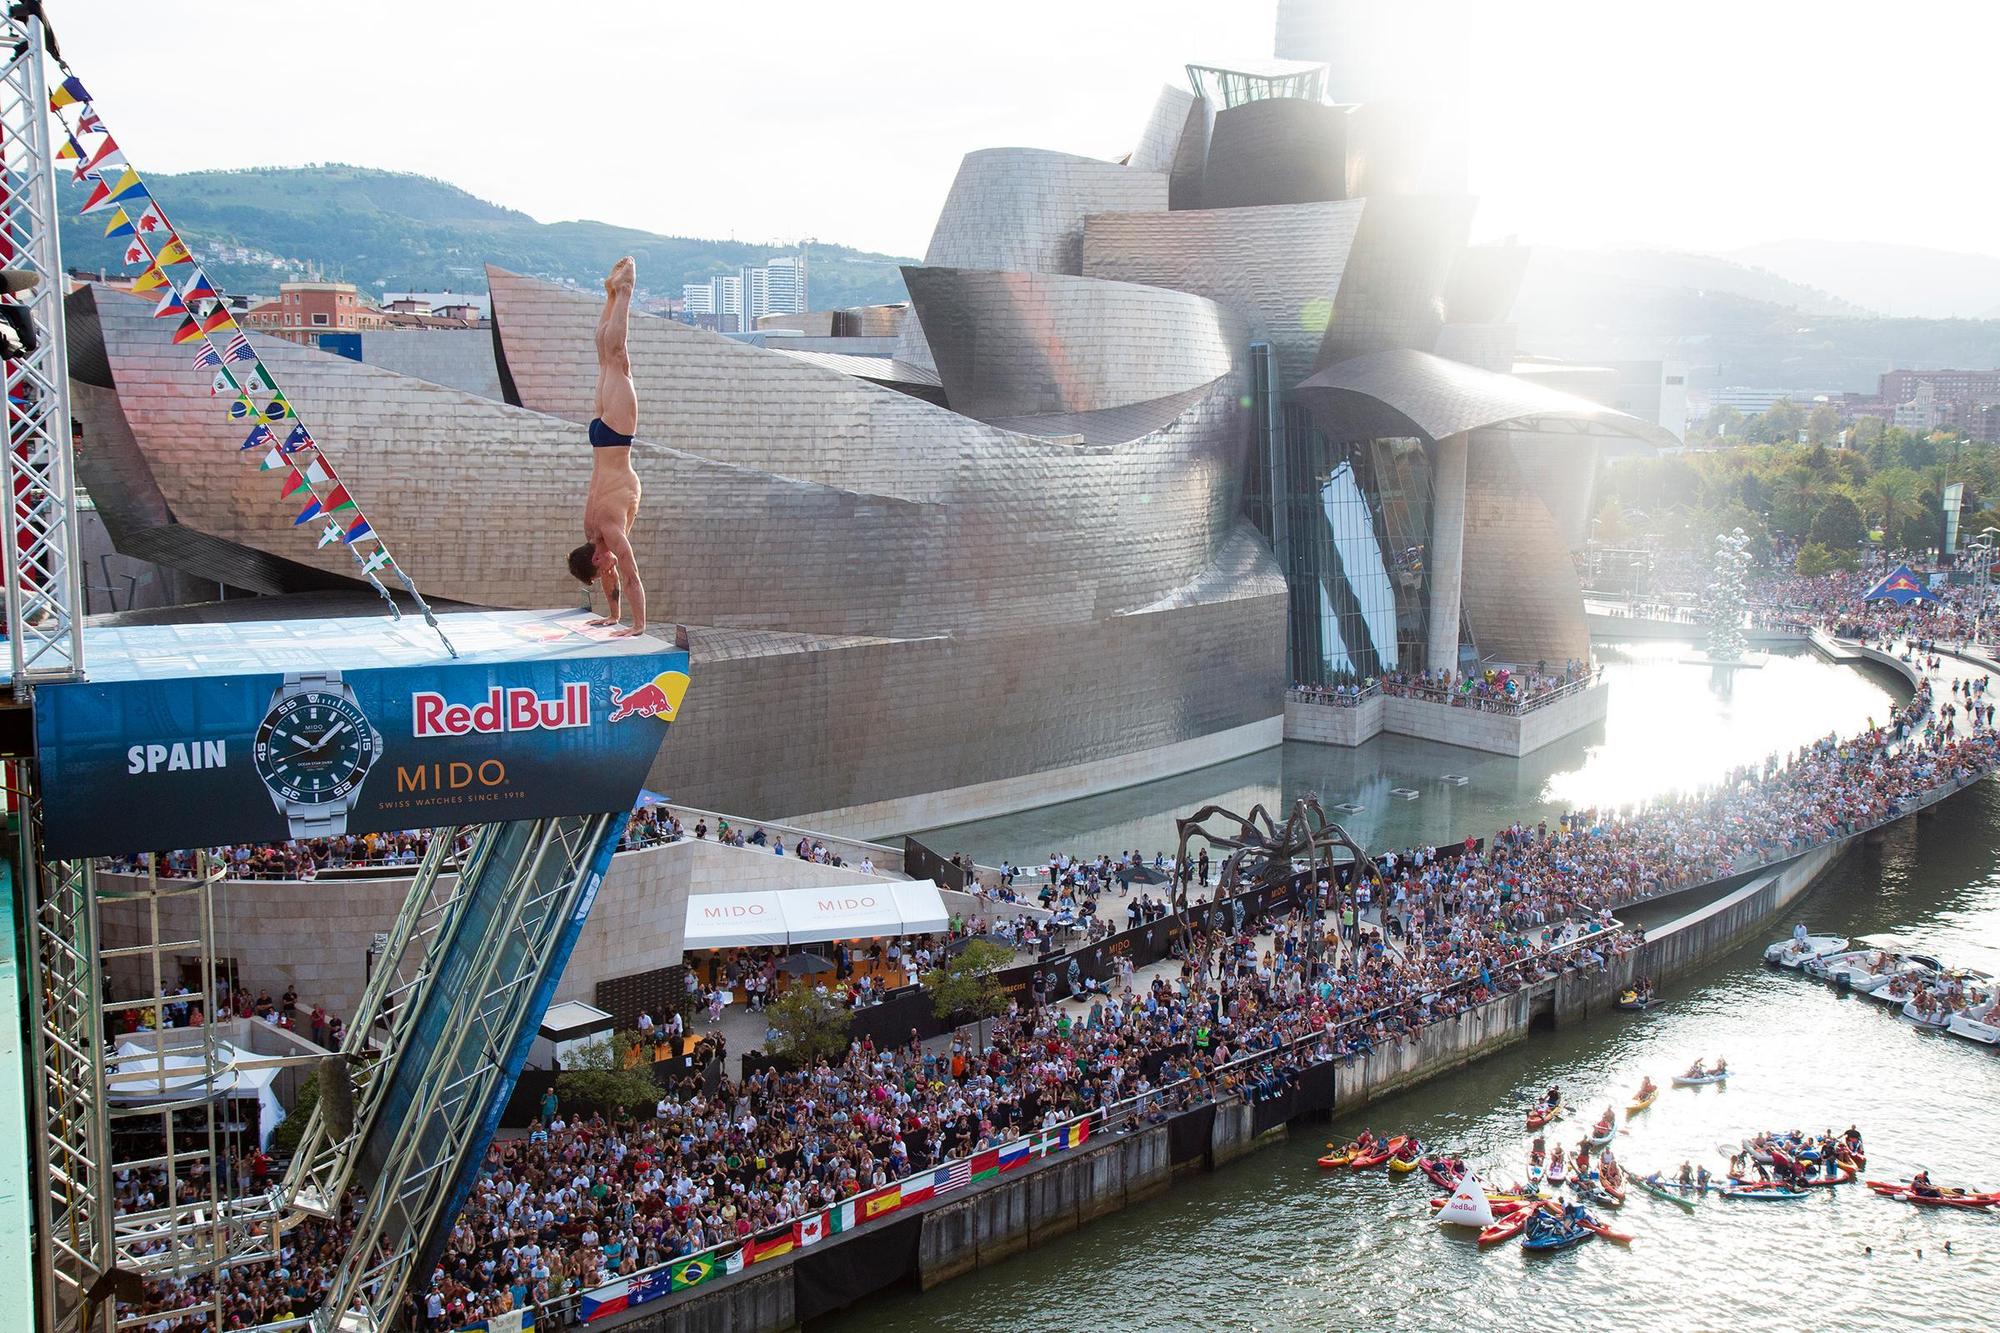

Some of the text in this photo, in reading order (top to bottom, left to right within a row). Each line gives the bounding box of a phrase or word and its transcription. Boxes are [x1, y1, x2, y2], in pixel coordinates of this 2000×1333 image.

[278, 699, 297, 715] 55
[415, 684, 590, 736] Red Bull
[257, 742, 267, 762] 45
[362, 738, 372, 751] 15
[127, 740, 227, 775] SPAIN
[397, 759, 505, 792] MIDO
[378, 791, 526, 810] SWISS WATCHES SINCE 1918
[704, 904, 764, 918] MIDO
[818, 897, 876, 911] MIDO
[1109, 939, 1131, 955] MIDO
[1451, 1202, 1477, 1212] Red Bull
